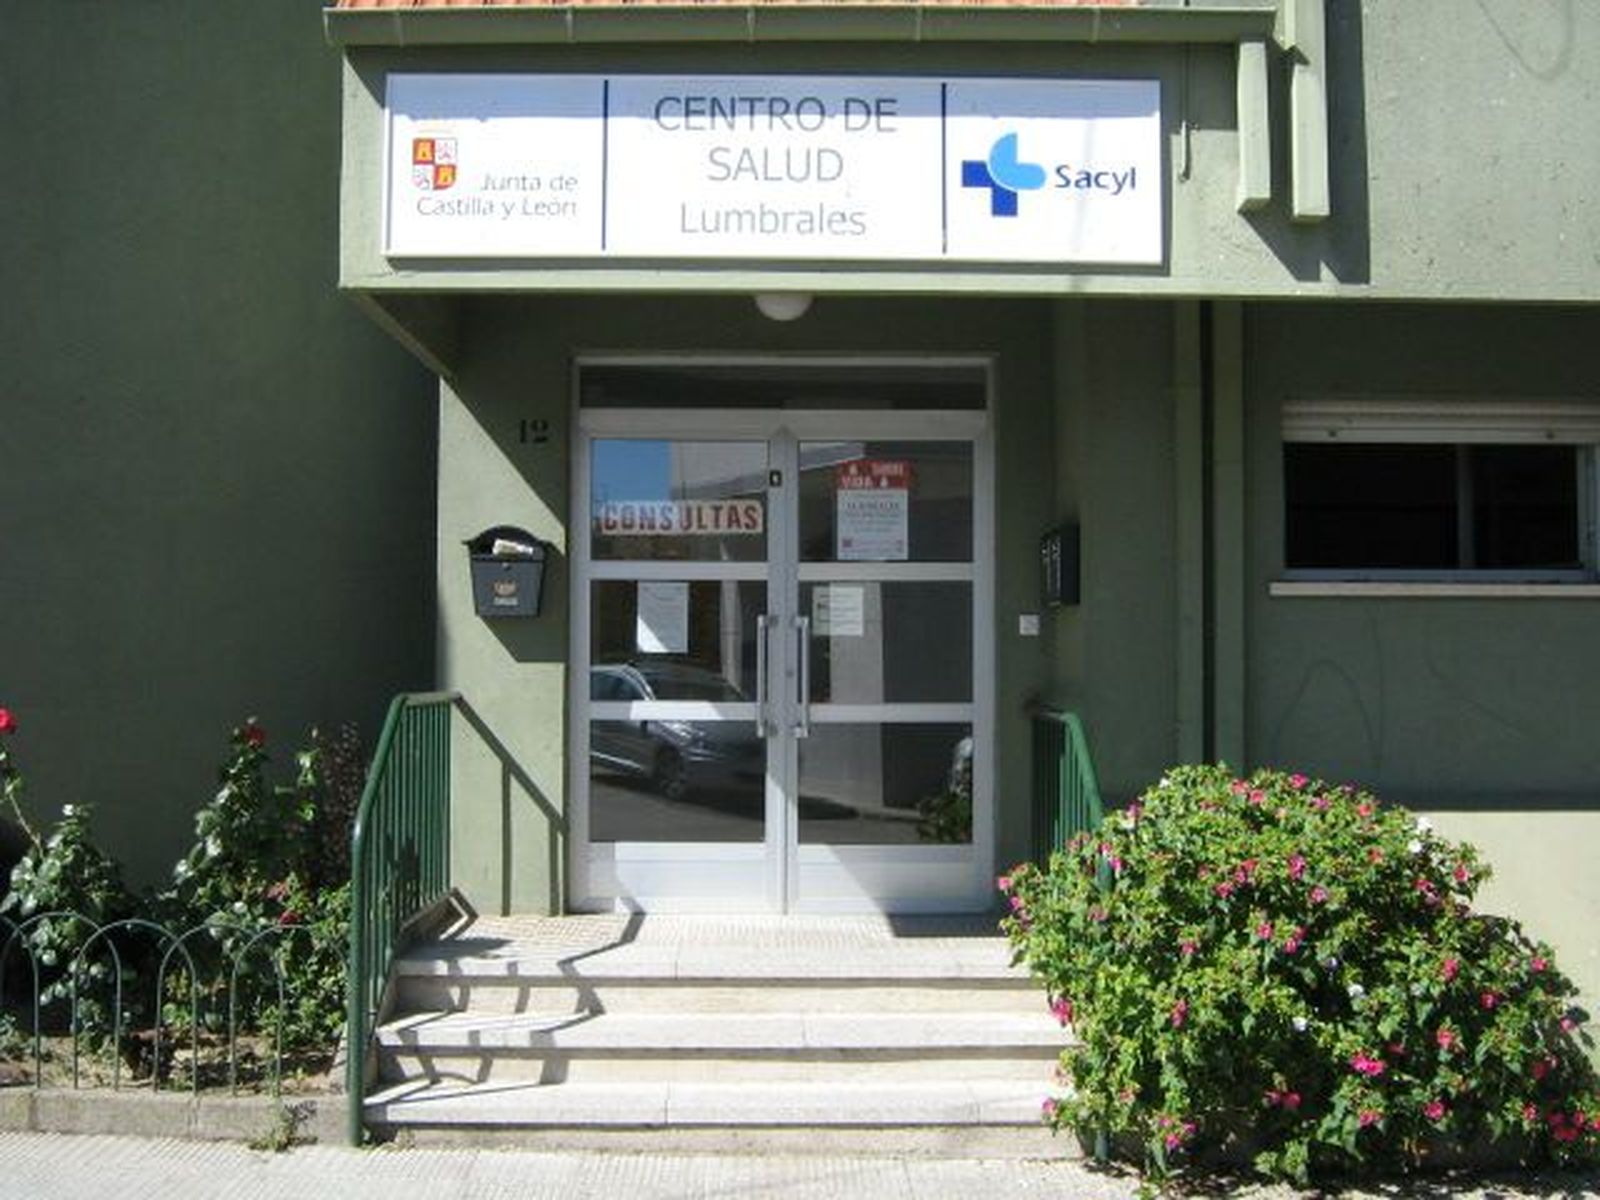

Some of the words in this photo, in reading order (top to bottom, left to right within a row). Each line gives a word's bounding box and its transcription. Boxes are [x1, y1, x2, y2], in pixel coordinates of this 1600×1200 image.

[654, 96, 828, 132] CENTRO
[844, 98, 898, 133] DE
[707, 147, 844, 182] SALUD
[1054, 164, 1137, 195] Sacyl
[480, 173, 541, 193] Junta
[549, 173, 578, 192] de
[416, 196, 495, 217] Castilla
[501, 200, 512, 221] y
[521, 195, 577, 216] León
[680, 202, 867, 237] Lumbrales
[604, 503, 759, 532] CONSULTAS
